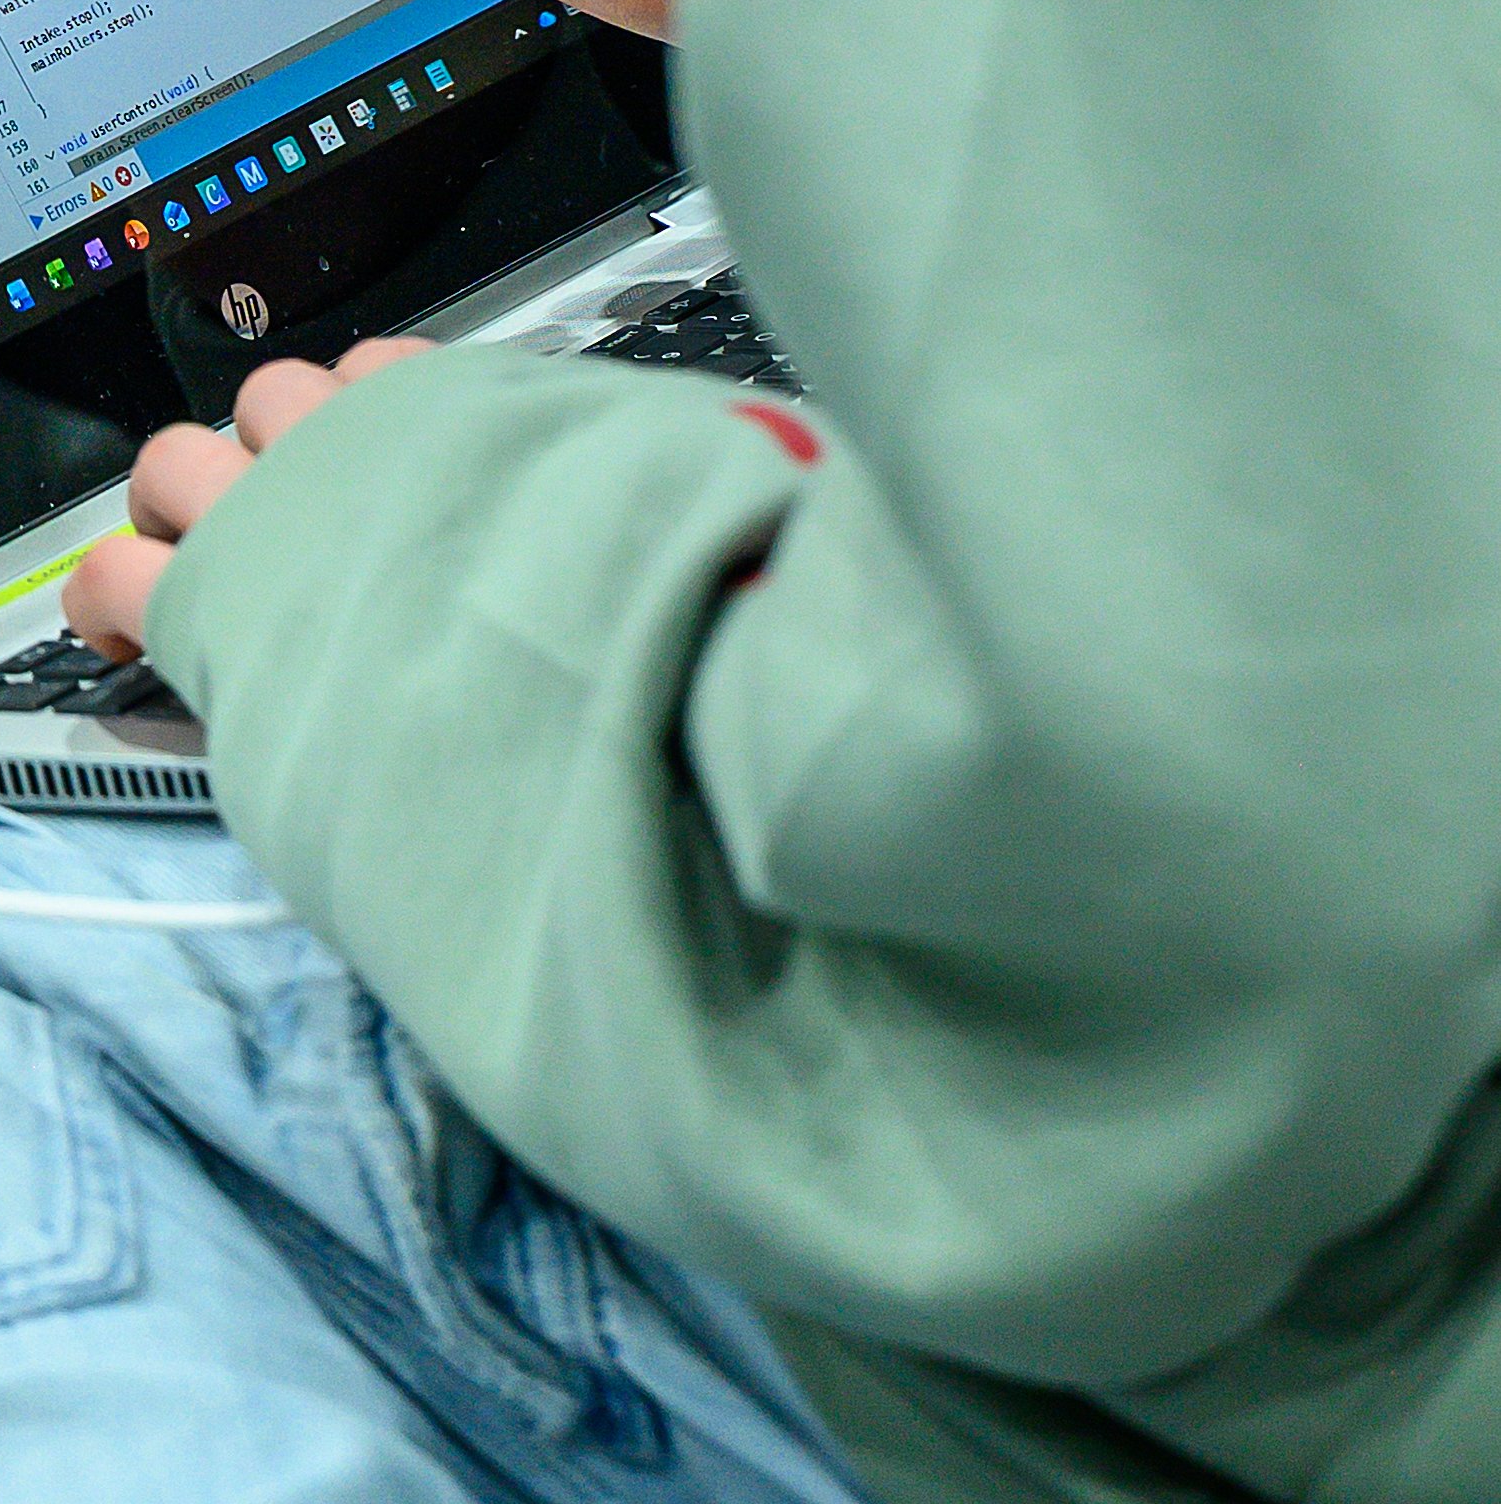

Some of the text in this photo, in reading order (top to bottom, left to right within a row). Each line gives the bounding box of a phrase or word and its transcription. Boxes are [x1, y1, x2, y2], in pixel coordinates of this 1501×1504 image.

[19, 1, 111, 53] Intake.stop();
[31, 4, 153, 72] mainRollers.stop();
[6, 138, 28, 158] 159
[16, 65, 214, 177] 160 void userControl(void) {
[26, 73, 254, 196] 161 Brain.Screen.clearScreen();
[44, 161, 141, 221] Errors 0 0
[226, 282, 261, 340] hp
